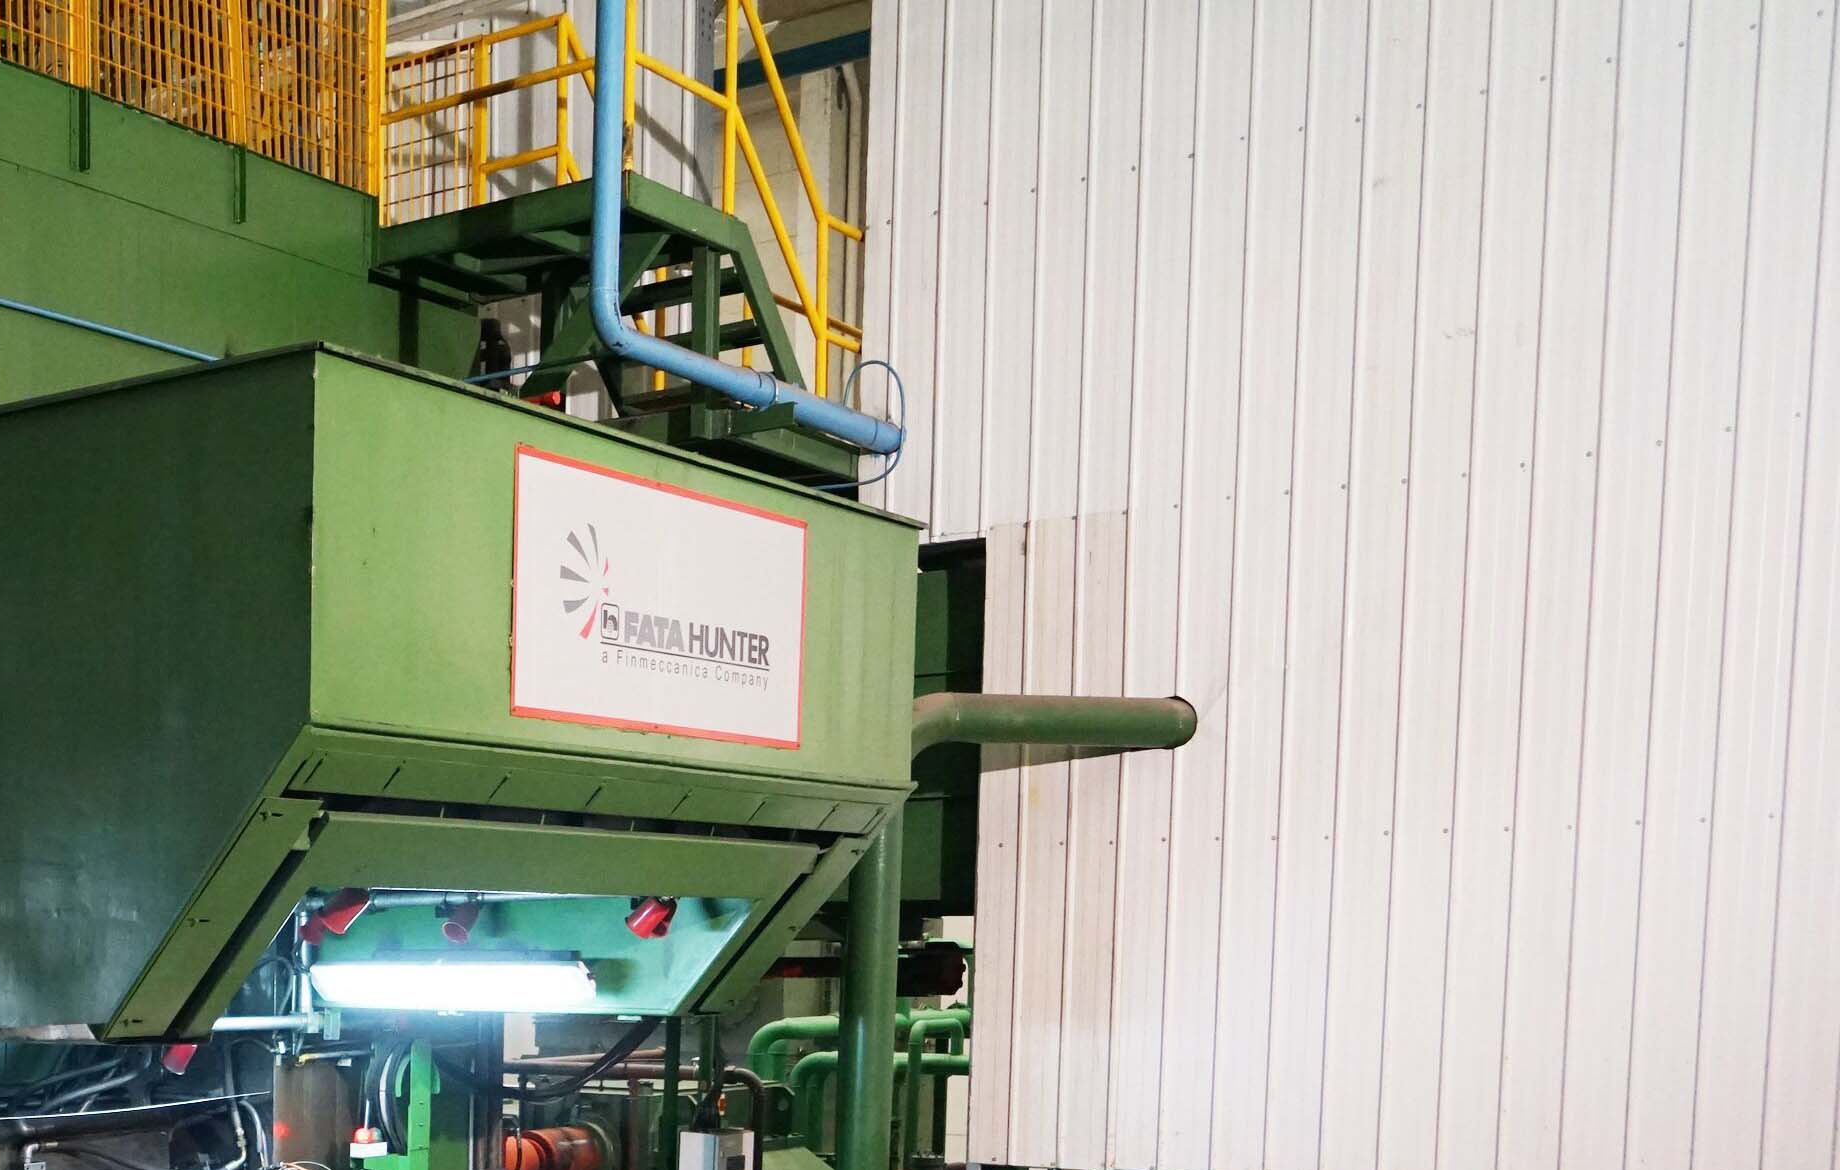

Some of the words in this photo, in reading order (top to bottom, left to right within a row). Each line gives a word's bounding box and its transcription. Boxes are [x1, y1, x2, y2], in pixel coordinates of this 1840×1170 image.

[624, 610, 685, 652] FATA
[688, 622, 769, 666] HUNTER
[601, 650, 609, 664] a
[616, 649, 709, 680] Finmeccanica
[714, 664, 769, 691] Company
